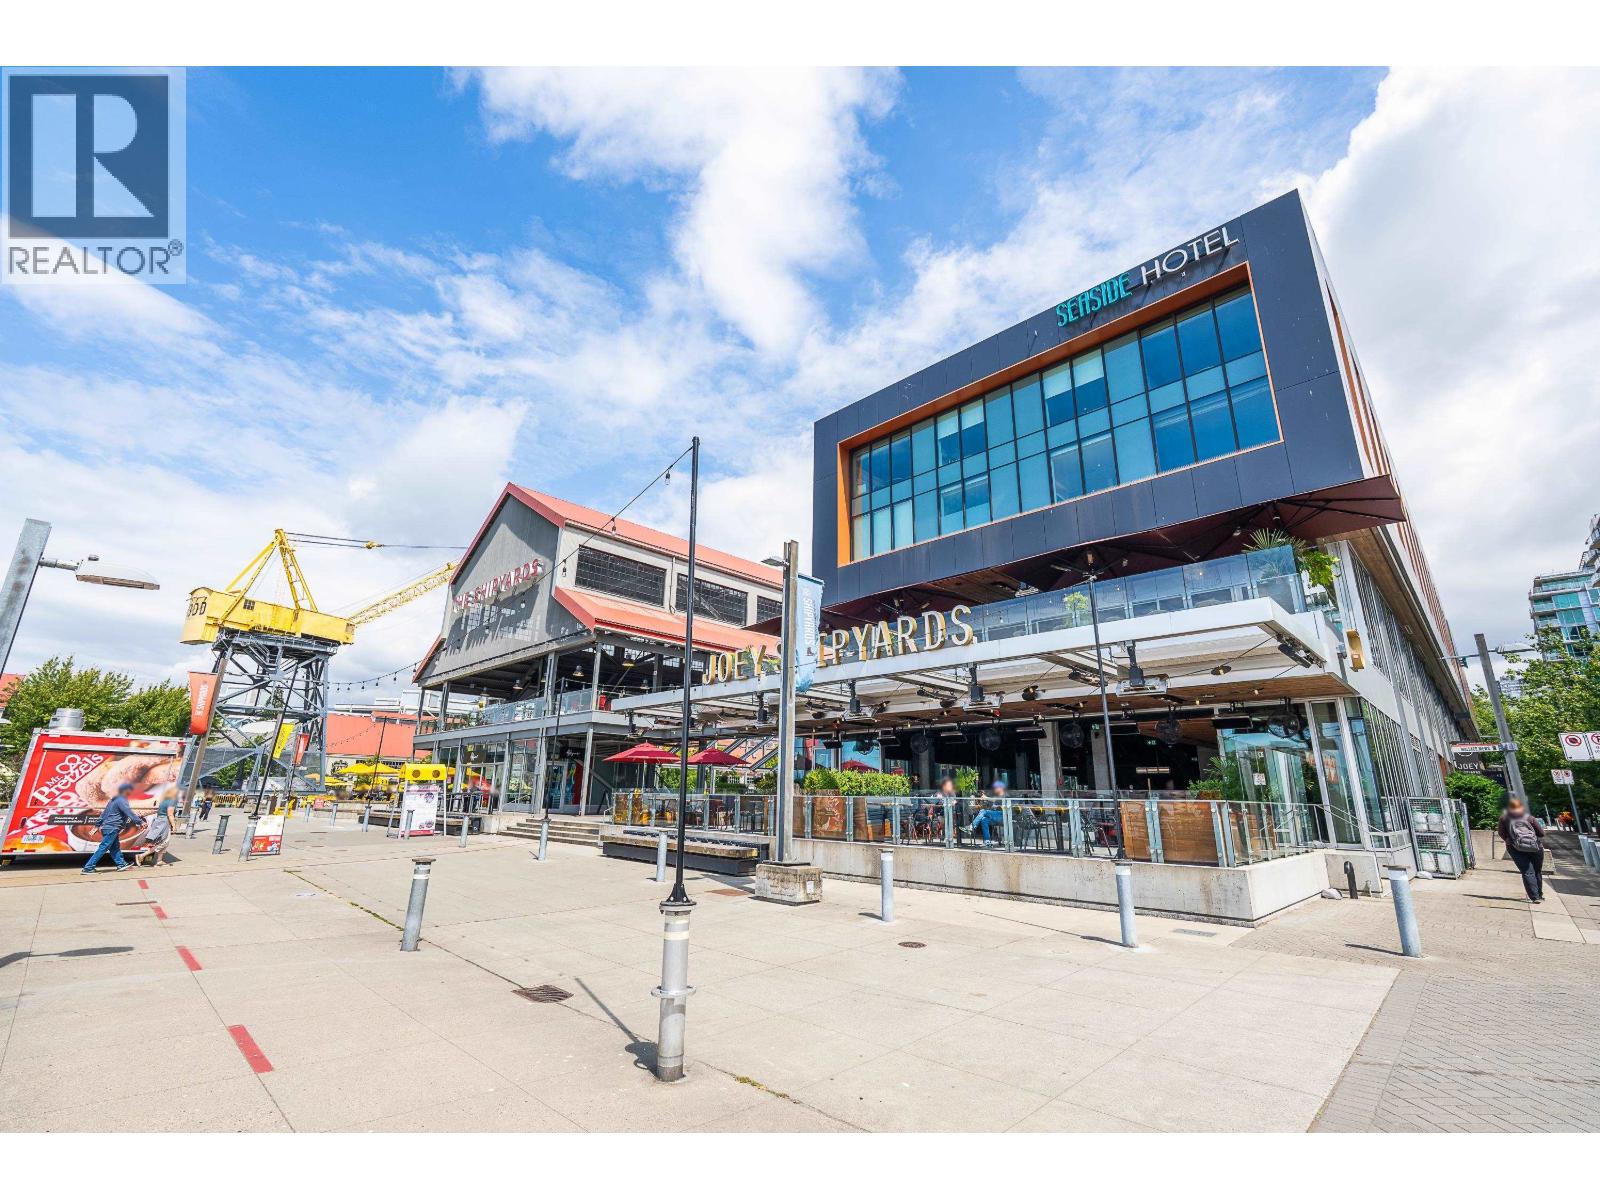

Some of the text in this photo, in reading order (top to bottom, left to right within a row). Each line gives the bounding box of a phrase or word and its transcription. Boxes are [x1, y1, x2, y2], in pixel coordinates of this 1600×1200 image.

[1055, 226, 1240, 328] SEASIDE HOTEL
[473, 558, 542, 604] SHIPYARDS
[702, 644, 767, 685] JOEY
[32, 753, 104, 805] Pretzel's
